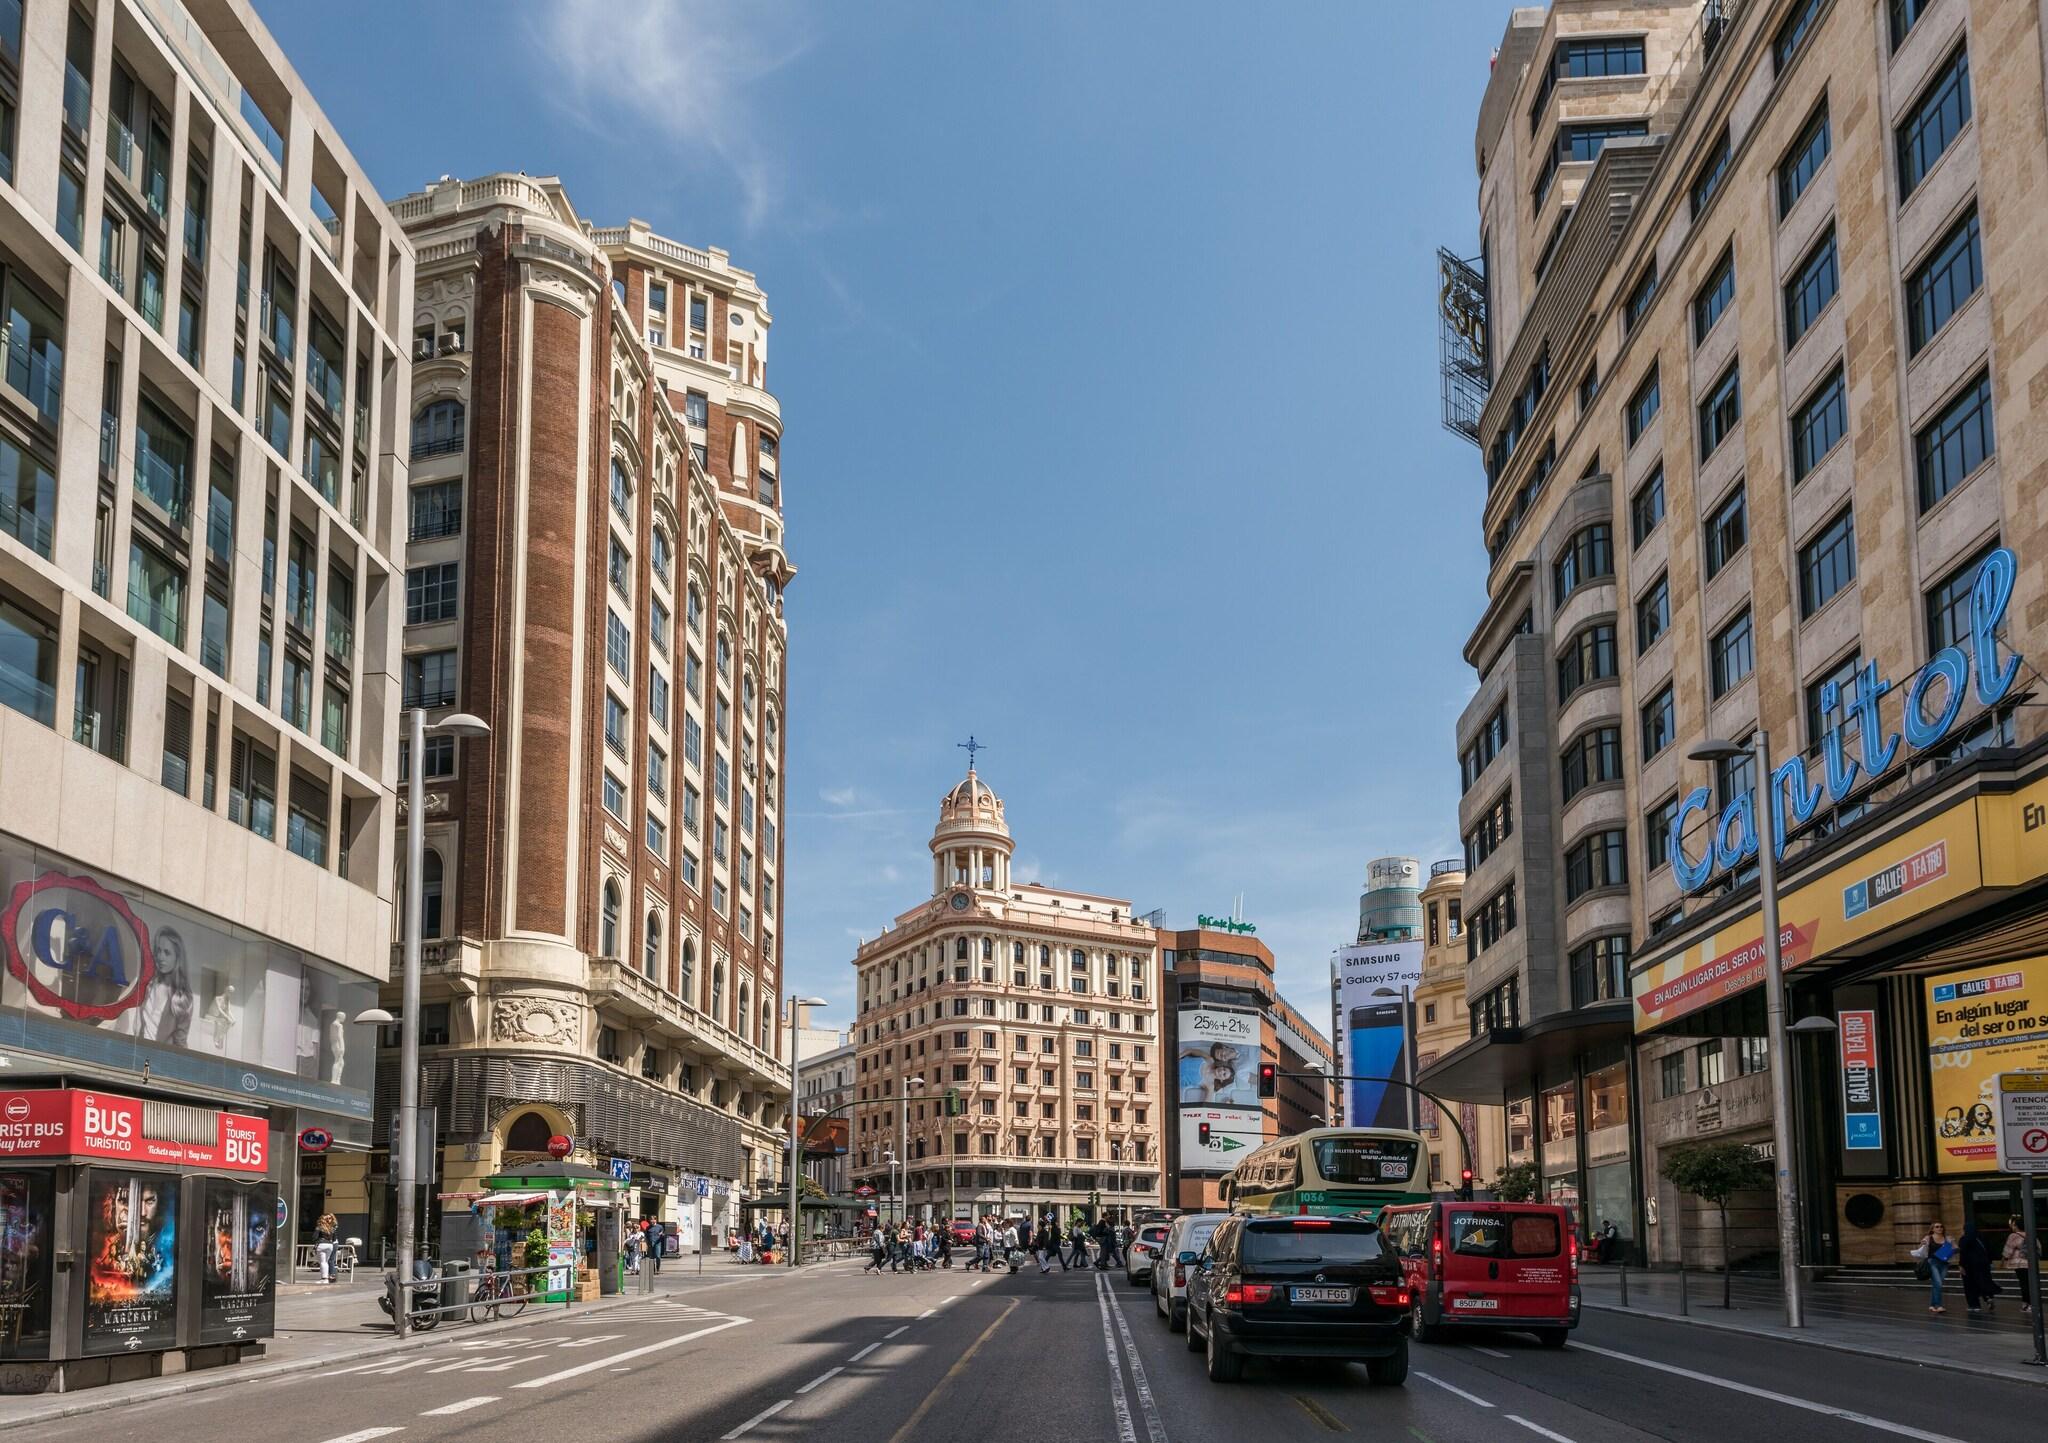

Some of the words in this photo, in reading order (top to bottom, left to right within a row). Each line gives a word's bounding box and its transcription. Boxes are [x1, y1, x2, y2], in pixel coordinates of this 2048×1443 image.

[1671, 547, 2023, 892] Capitol
[2023, 802, 2046, 832] En
[1875, 865, 1907, 897] GALILEO
[1912, 848, 1942, 880] TEATRO
[31, 908, 130, 986] C&A
[1346, 954, 1400, 967] SAMSUNG
[1655, 993, 1663, 1005] EN
[1664, 980, 1688, 1000] ALGÚN
[1690, 969, 1714, 989] LUGAR
[1715, 961, 1730, 977] DEL
[1732, 951, 1749, 968] SER
[1750, 948, 1757, 960] O
[1759, 943, 1765, 957] N
[1780, 930, 1793, 947] ER
[1346, 975, 1386, 985] Galaxy
[1387, 972, 1399, 981] S7
[1401, 972, 1420, 981] edg
[1725, 976, 1745, 992] Desde
[1747, 973, 1753, 983] el
[1754, 968, 1762, 978] 19
[1781, 955, 1794, 970] ayo
[1962, 979, 1990, 994] GALILEO
[1994, 974, 2020, 988] TEATRO
[1936, 1010, 1953, 1024] En
[1955, 1003, 1991, 1022] algún
[1994, 999, 2029, 1016] lugar
[1845, 1016, 1868, 1054] TEATRO
[1960, 1022, 1980, 1038] del
[1983, 1021, 2003, 1035] ser
[2006, 1020, 2015, 1031] o
[2018, 1017, 2035, 1030] no
[2039, 1015, 2048, 1027] se
[1938, 1041, 1984, 1052] Shakespeare
[1985, 1038, 1991, 1046] &
[1992, 1035, 2028, 1045] Cervantes
[1847, 1060, 1870, 1103] GALILEO
[0, 1124, 32, 1137] RIST
[34, 1123, 64, 1136] BUS
[84, 1107, 132, 1138] BUS
[17, 1138, 41, 1149] here
[84, 1136, 131, 1151] TURÍSTICO
[226, 1128, 256, 1140] TOURIST
[188, 1150, 200, 1161] Buy
[201, 1152, 213, 1161] here
[226, 1139, 262, 1165] BUS
[1300, 1192, 1324, 1202] 1036
[1454, 1217, 1500, 1226] JOTRINSA
[1298, 1289, 1322, 1299] 5941
[1328, 1289, 1347, 1298] FGG
[104, 1311, 159, 1324] WARCRAFT
